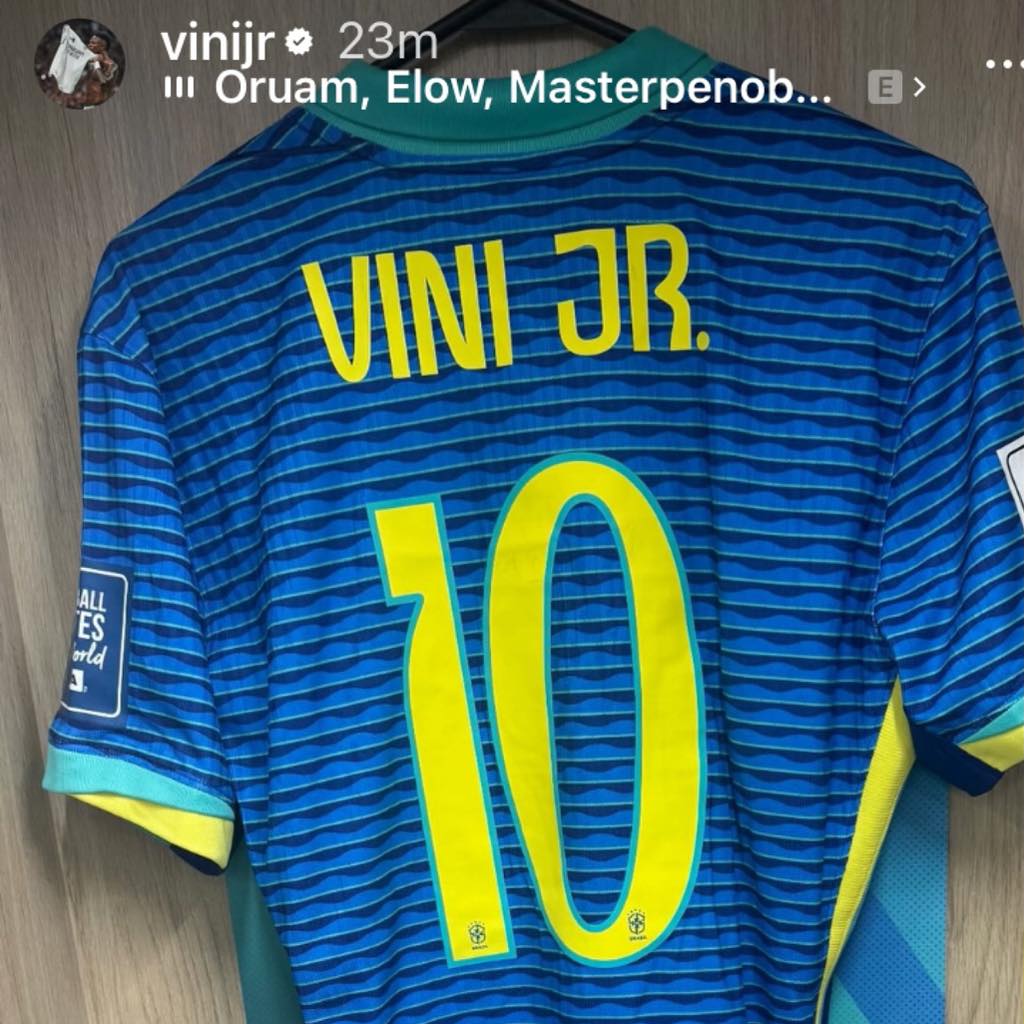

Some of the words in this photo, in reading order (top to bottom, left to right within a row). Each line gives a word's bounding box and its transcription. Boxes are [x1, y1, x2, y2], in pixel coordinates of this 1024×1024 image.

[301, 239, 513, 383] VINI
[554, 223, 710, 357] JR.
[76, 588, 107, 612] ALL
[76, 610, 105, 641] ES
[366, 452, 707, 968] 10
